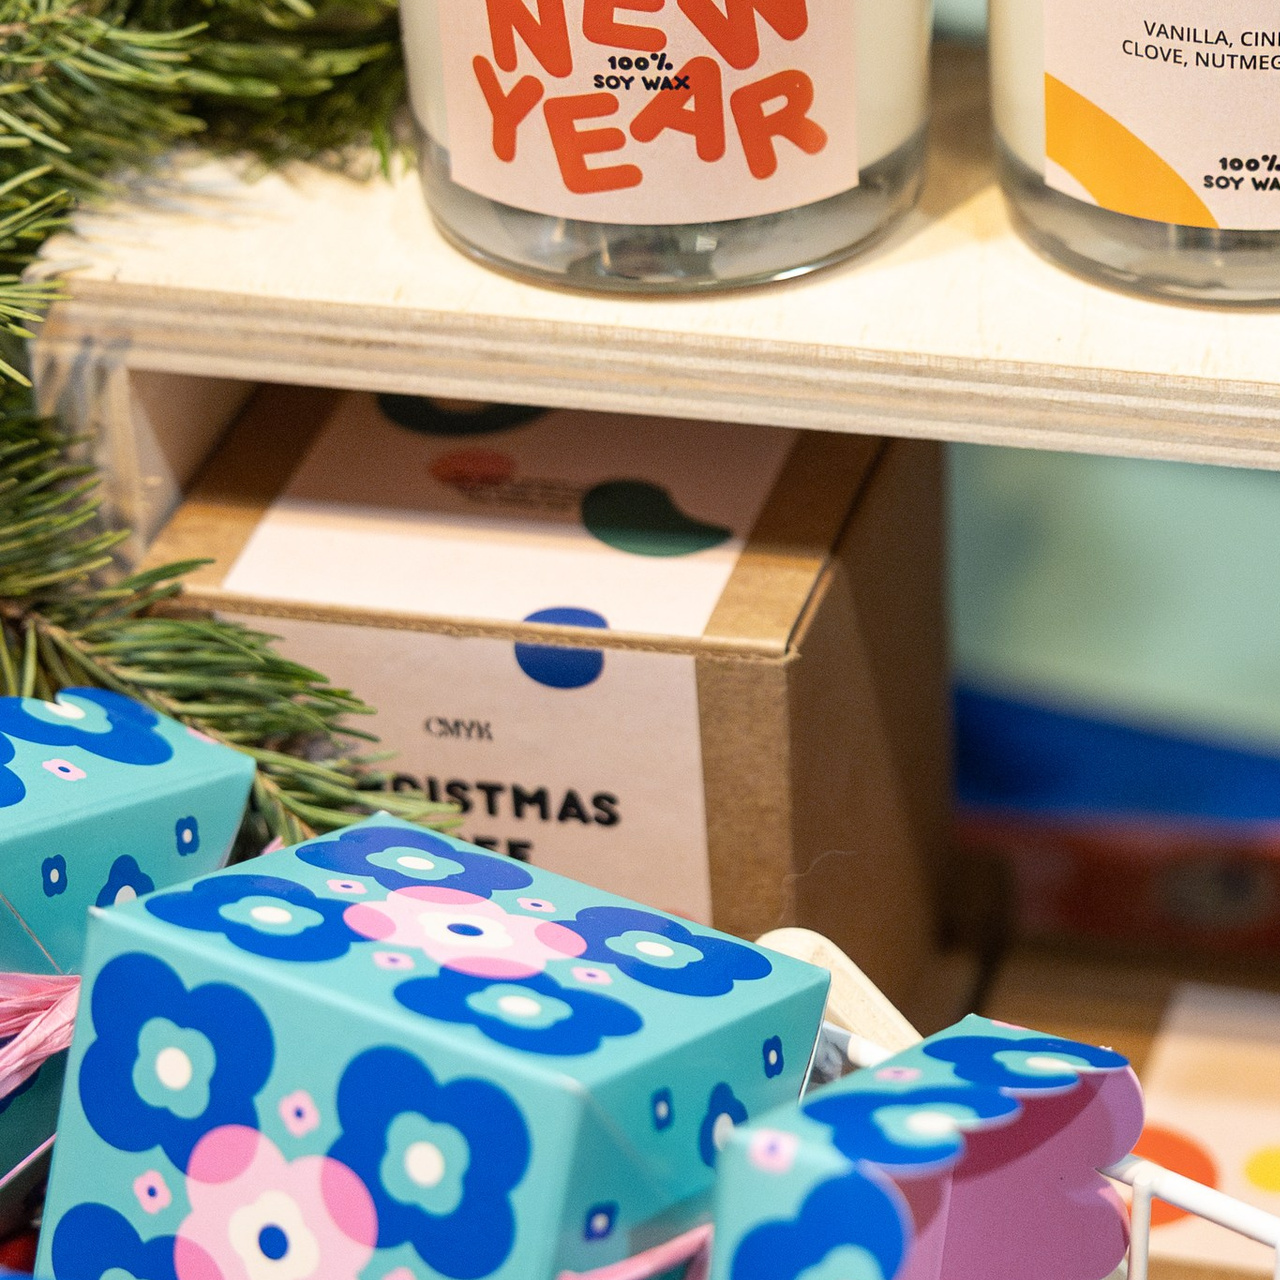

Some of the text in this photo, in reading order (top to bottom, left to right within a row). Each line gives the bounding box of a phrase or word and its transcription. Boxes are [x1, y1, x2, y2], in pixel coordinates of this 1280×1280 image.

[1143, 19, 1234, 47] VANILLA,
[607, 51, 674, 72] 100%
[1121, 38, 1190, 69] CLOVE,
[593, 74, 691, 92] SOY WAX
[472, 54, 828, 196] YEAR
[1202, 175, 1244, 191] SOY
[424, 716, 493, 741] CMYK
